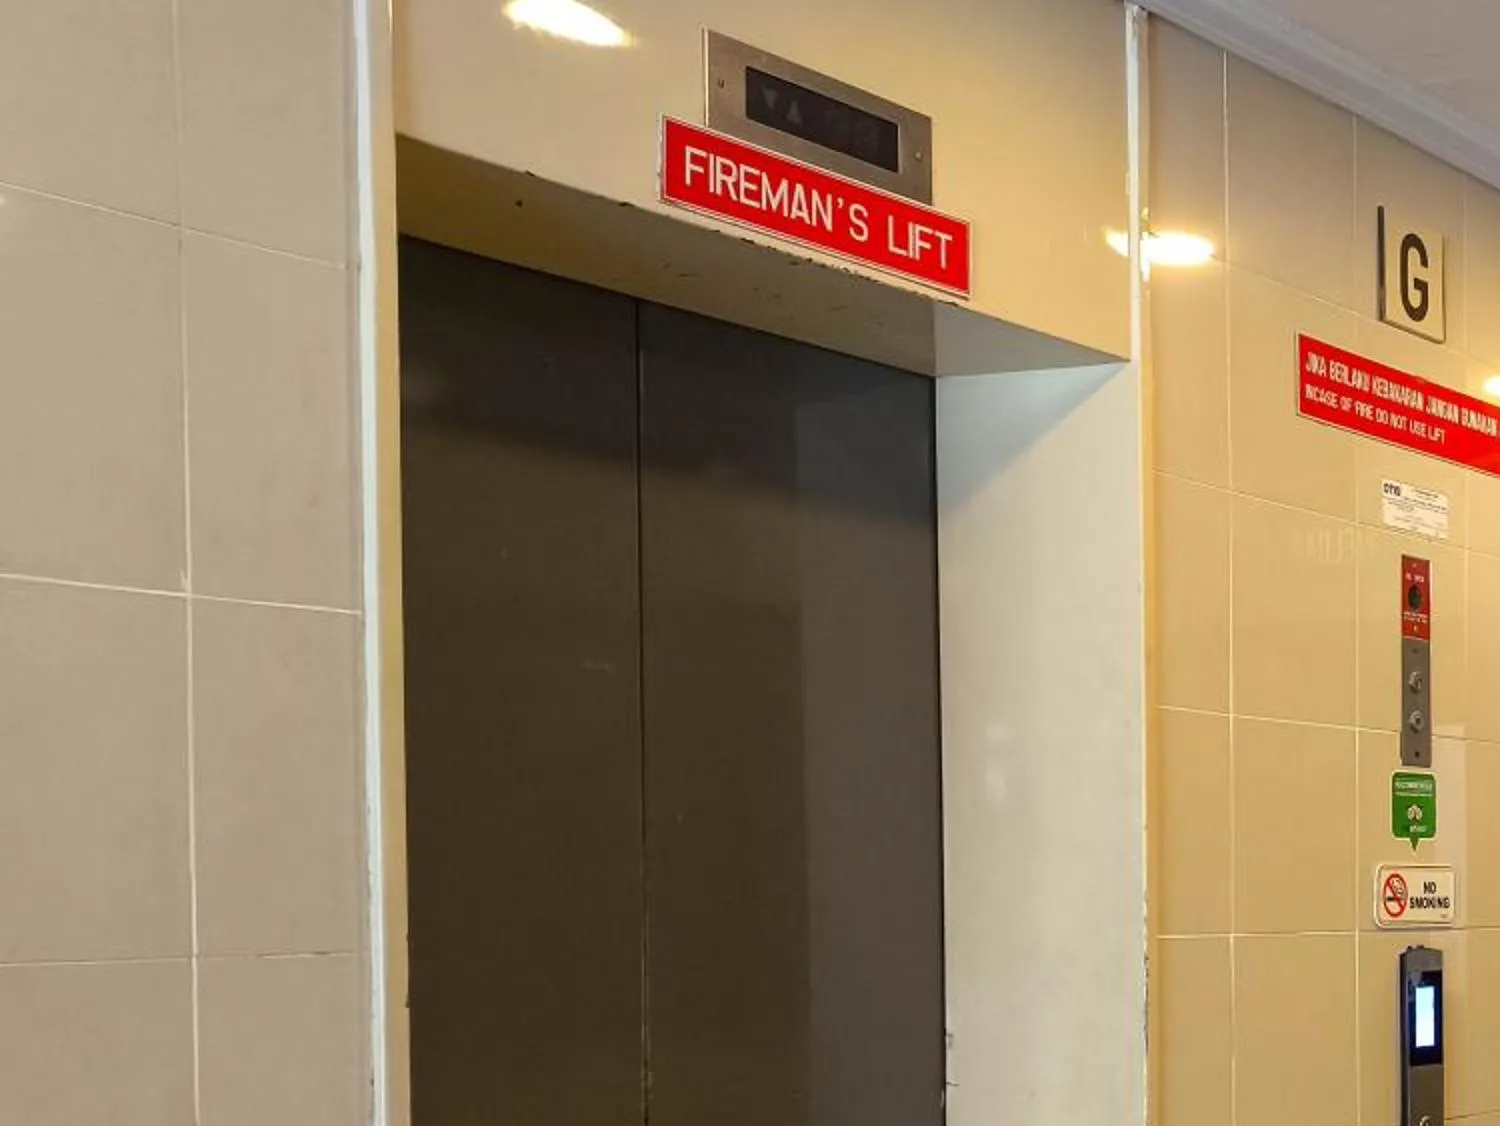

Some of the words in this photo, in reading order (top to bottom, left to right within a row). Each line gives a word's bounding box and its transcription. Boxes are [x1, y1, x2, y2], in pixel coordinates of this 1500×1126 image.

[684, 145, 869, 243] FIREMAN'S
[887, 215, 953, 270] LIFT
[1400, 233, 1429, 322] G
[1305, 351, 1327, 378] JIKA
[1426, 395, 1459, 425] JANGAN
[1461, 407, 1497, 438] GUNAKAN
[1340, 395, 1353, 413] OF
[1354, 400, 1374, 421] FIRE
[1375, 407, 1389, 425] DO
[1389, 412, 1408, 431] NOT
[1409, 419, 1427, 438] USE
[1427, 425, 1446, 446] LIFT
[1409, 896, 1451, 909] SMOKING
[1423, 881, 1437, 895] NO
